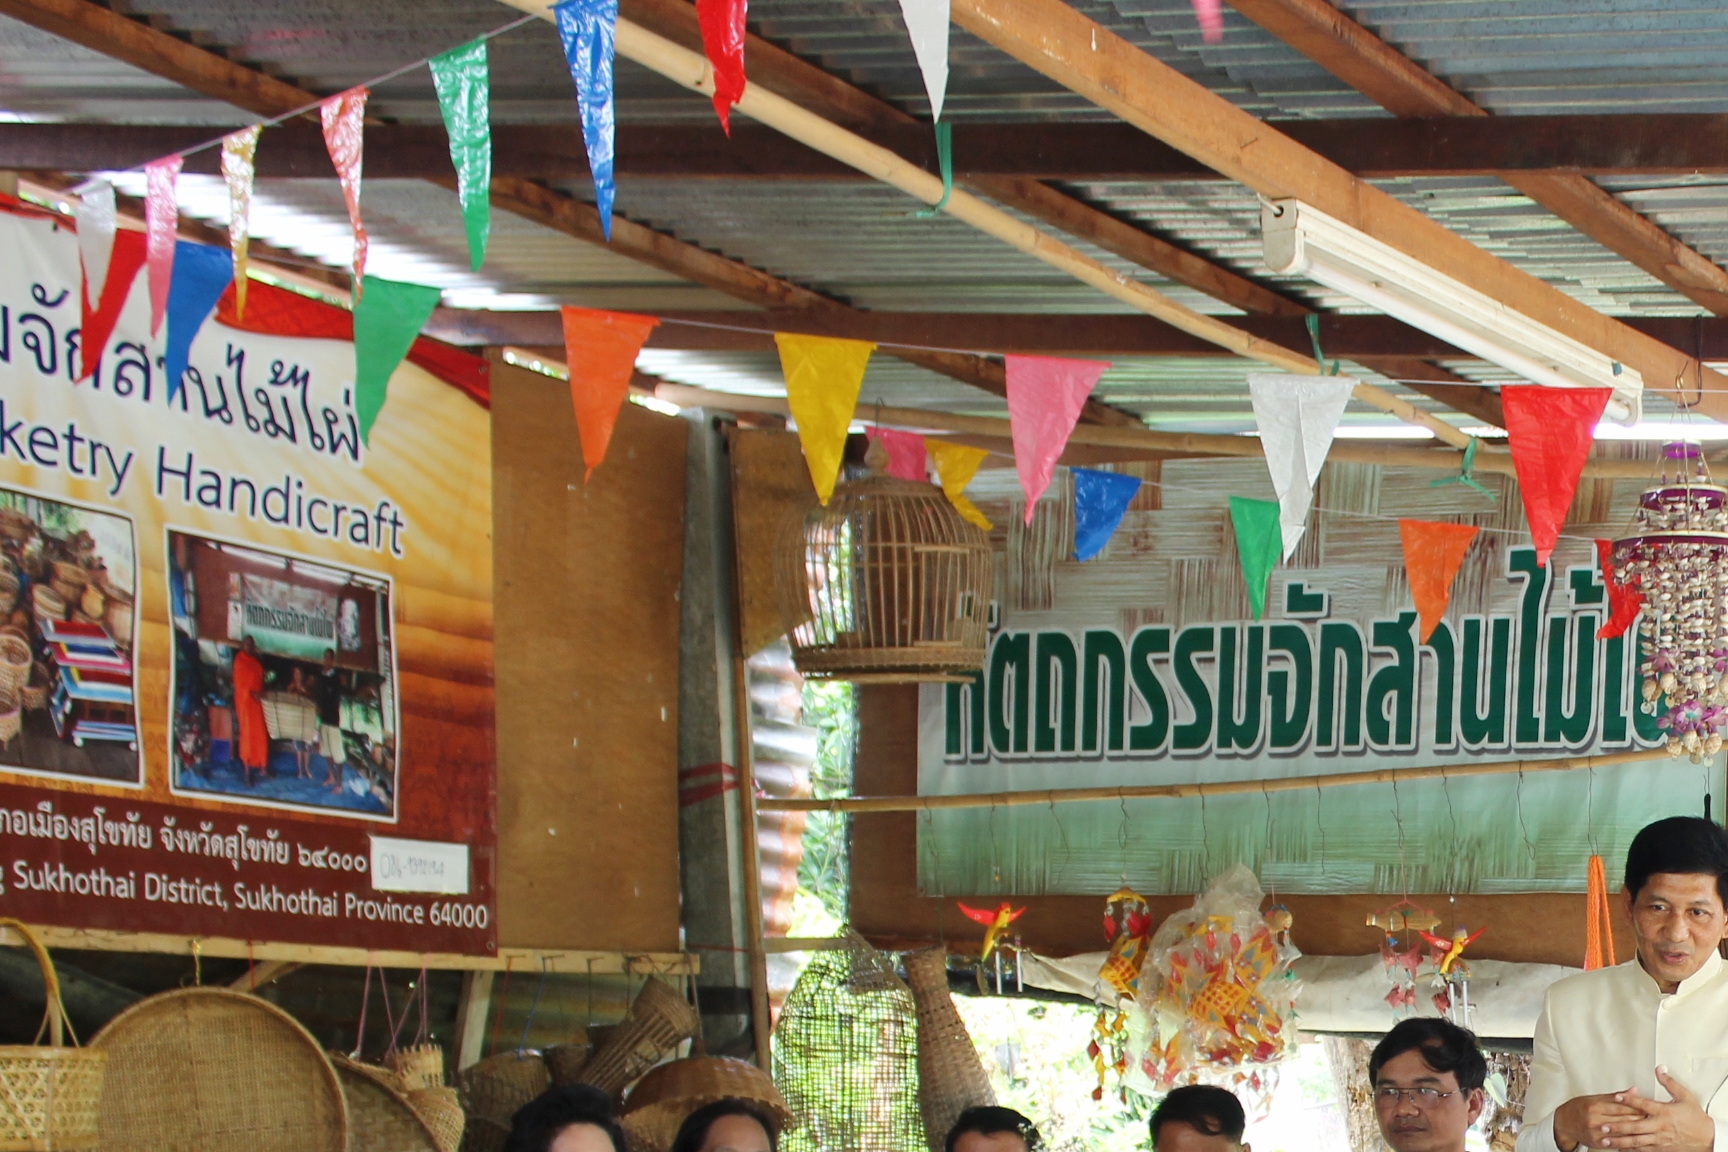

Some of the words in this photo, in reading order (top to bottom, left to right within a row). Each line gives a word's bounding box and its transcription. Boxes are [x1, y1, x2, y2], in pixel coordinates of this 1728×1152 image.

[0, 283, 359, 462] จักสานไม้ไผ่
[155, 445, 405, 555] Handicraft
[160, 816, 291, 870] จังหวัดสุโขทัย
[298, 841, 367, 876] ๖๔๐๐๐
[13, 859, 137, 900] Sukhothai
[144, 872, 229, 912] District,
[234, 876, 338, 917] Sukhothai
[344, 893, 425, 926] Province
[429, 902, 489, 930] 64000
